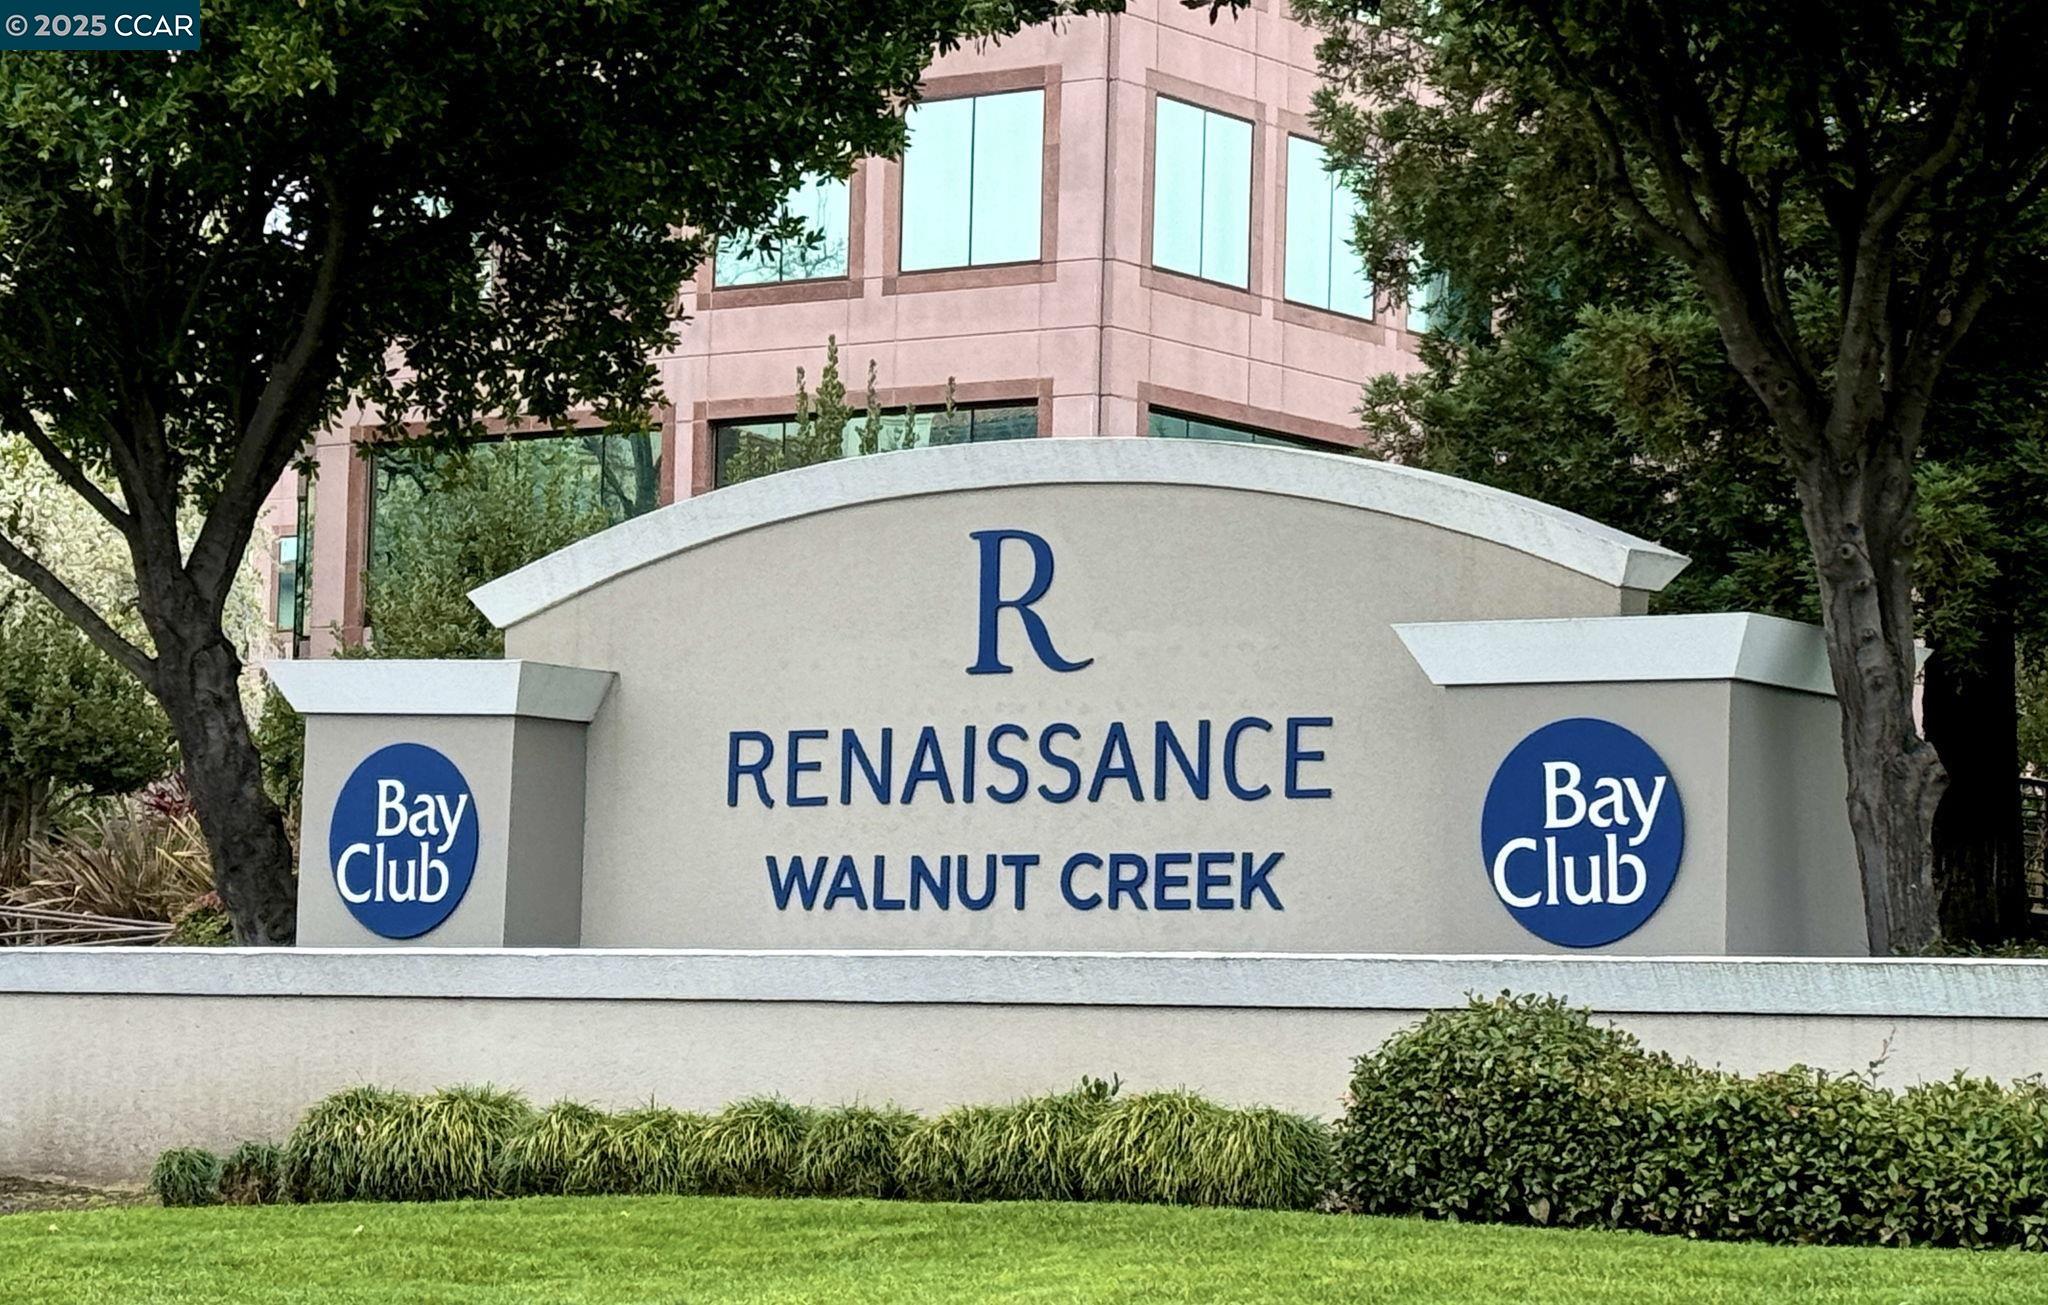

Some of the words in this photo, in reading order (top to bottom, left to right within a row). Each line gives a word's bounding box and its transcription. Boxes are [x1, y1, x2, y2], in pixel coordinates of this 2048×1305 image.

[968, 529, 1091, 675] R
[728, 717, 1333, 808] RENAISSANCE
[376, 779, 468, 854] Bay
[1542, 761, 1667, 847] Bay
[336, 842, 449, 905] Club
[767, 854, 1040, 911] WALNUT
[1060, 852, 1286, 911] CREEK
[1493, 833, 1647, 908] Club
